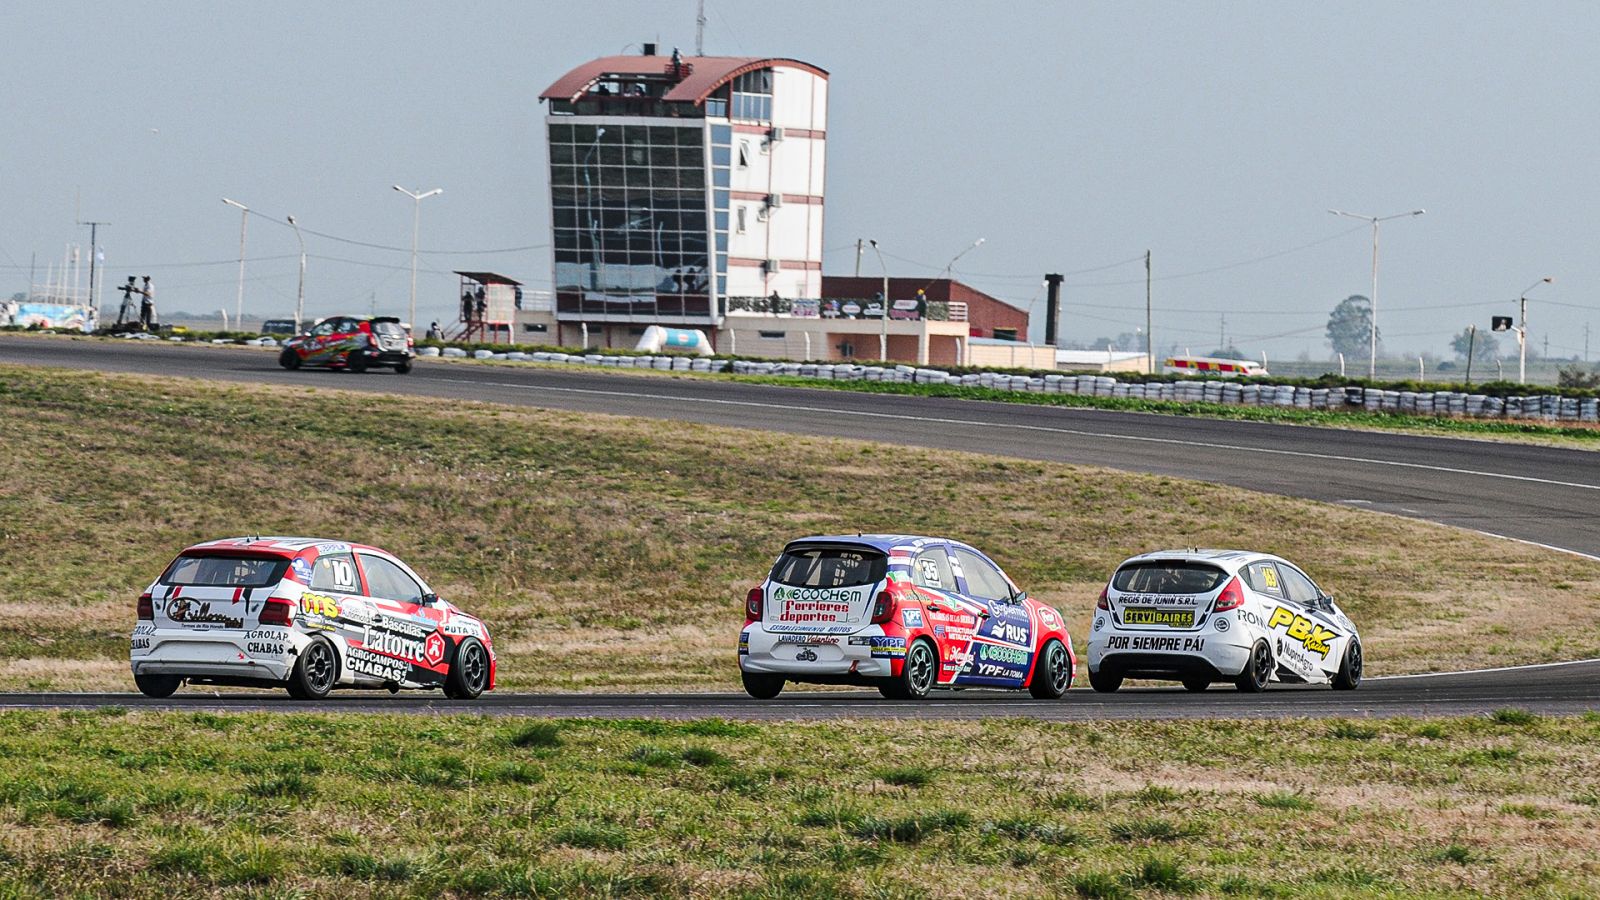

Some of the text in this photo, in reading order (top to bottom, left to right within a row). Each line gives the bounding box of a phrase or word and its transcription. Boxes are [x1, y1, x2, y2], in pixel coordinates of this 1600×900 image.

[331, 560, 353, 586] 10
[922, 560, 939, 581] 35
[792, 588, 861, 602] ECOCHEM
[1118, 596, 1141, 604] REGIS
[780, 611, 836, 624] deportes
[1268, 605, 1343, 644] PBK
[445, 625, 468, 634] RUTA
[1006, 624, 1027, 643] RUS
[247, 642, 284, 654] CHABAS
[362, 624, 425, 662] Latorre
[872, 637, 905, 648] YPF
[1107, 636, 1130, 650] POR
[1132, 637, 1181, 651] SIEMPRE
[347, 647, 404, 669] AGROCAMPOS
[346, 657, 401, 681] CHABAS
[978, 663, 1004, 676] YPF
